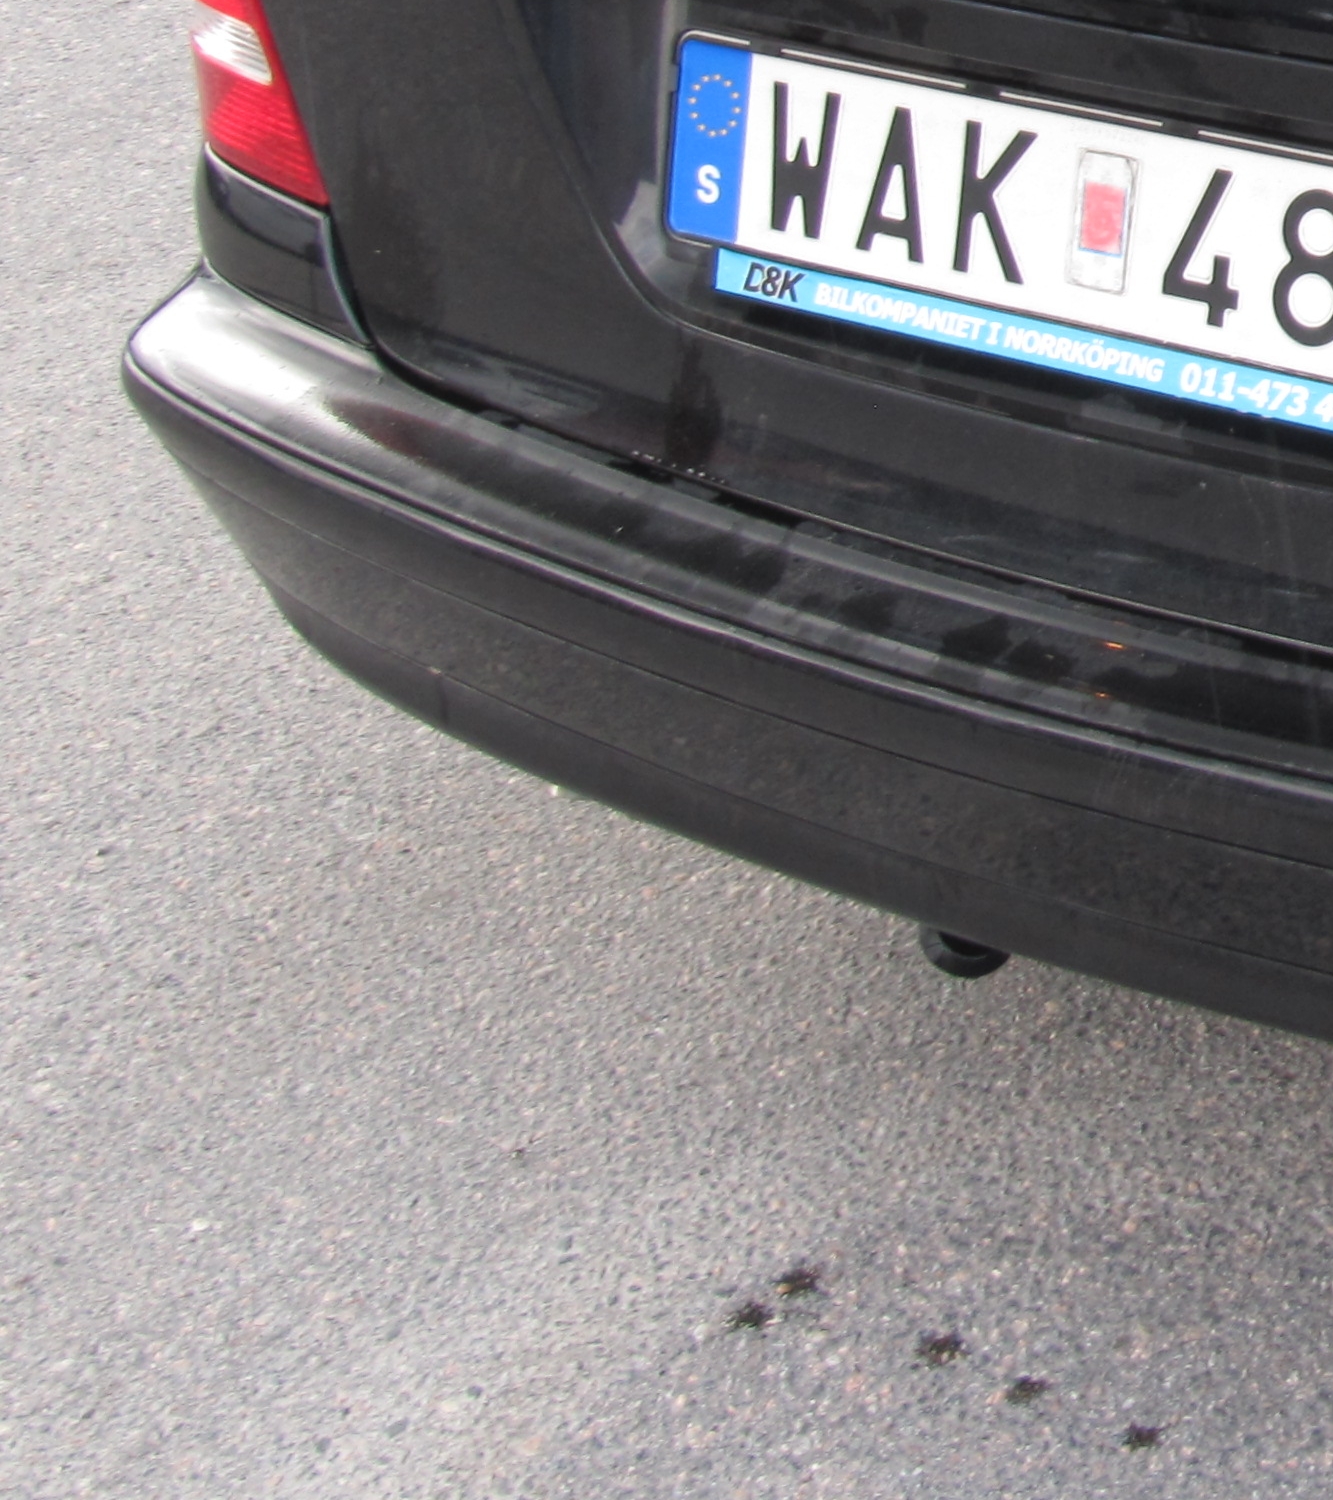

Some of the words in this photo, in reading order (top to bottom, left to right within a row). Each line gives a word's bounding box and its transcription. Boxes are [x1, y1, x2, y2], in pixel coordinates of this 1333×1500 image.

[696, 165, 721, 204] S
[770, 80, 1038, 285] WAK
[743, 261, 806, 302] D&K
[814, 282, 984, 341] BILKOMPANIET
[1003, 326, 1166, 383] NORRKÖPING
[1179, 362, 1311, 417] 011-473
